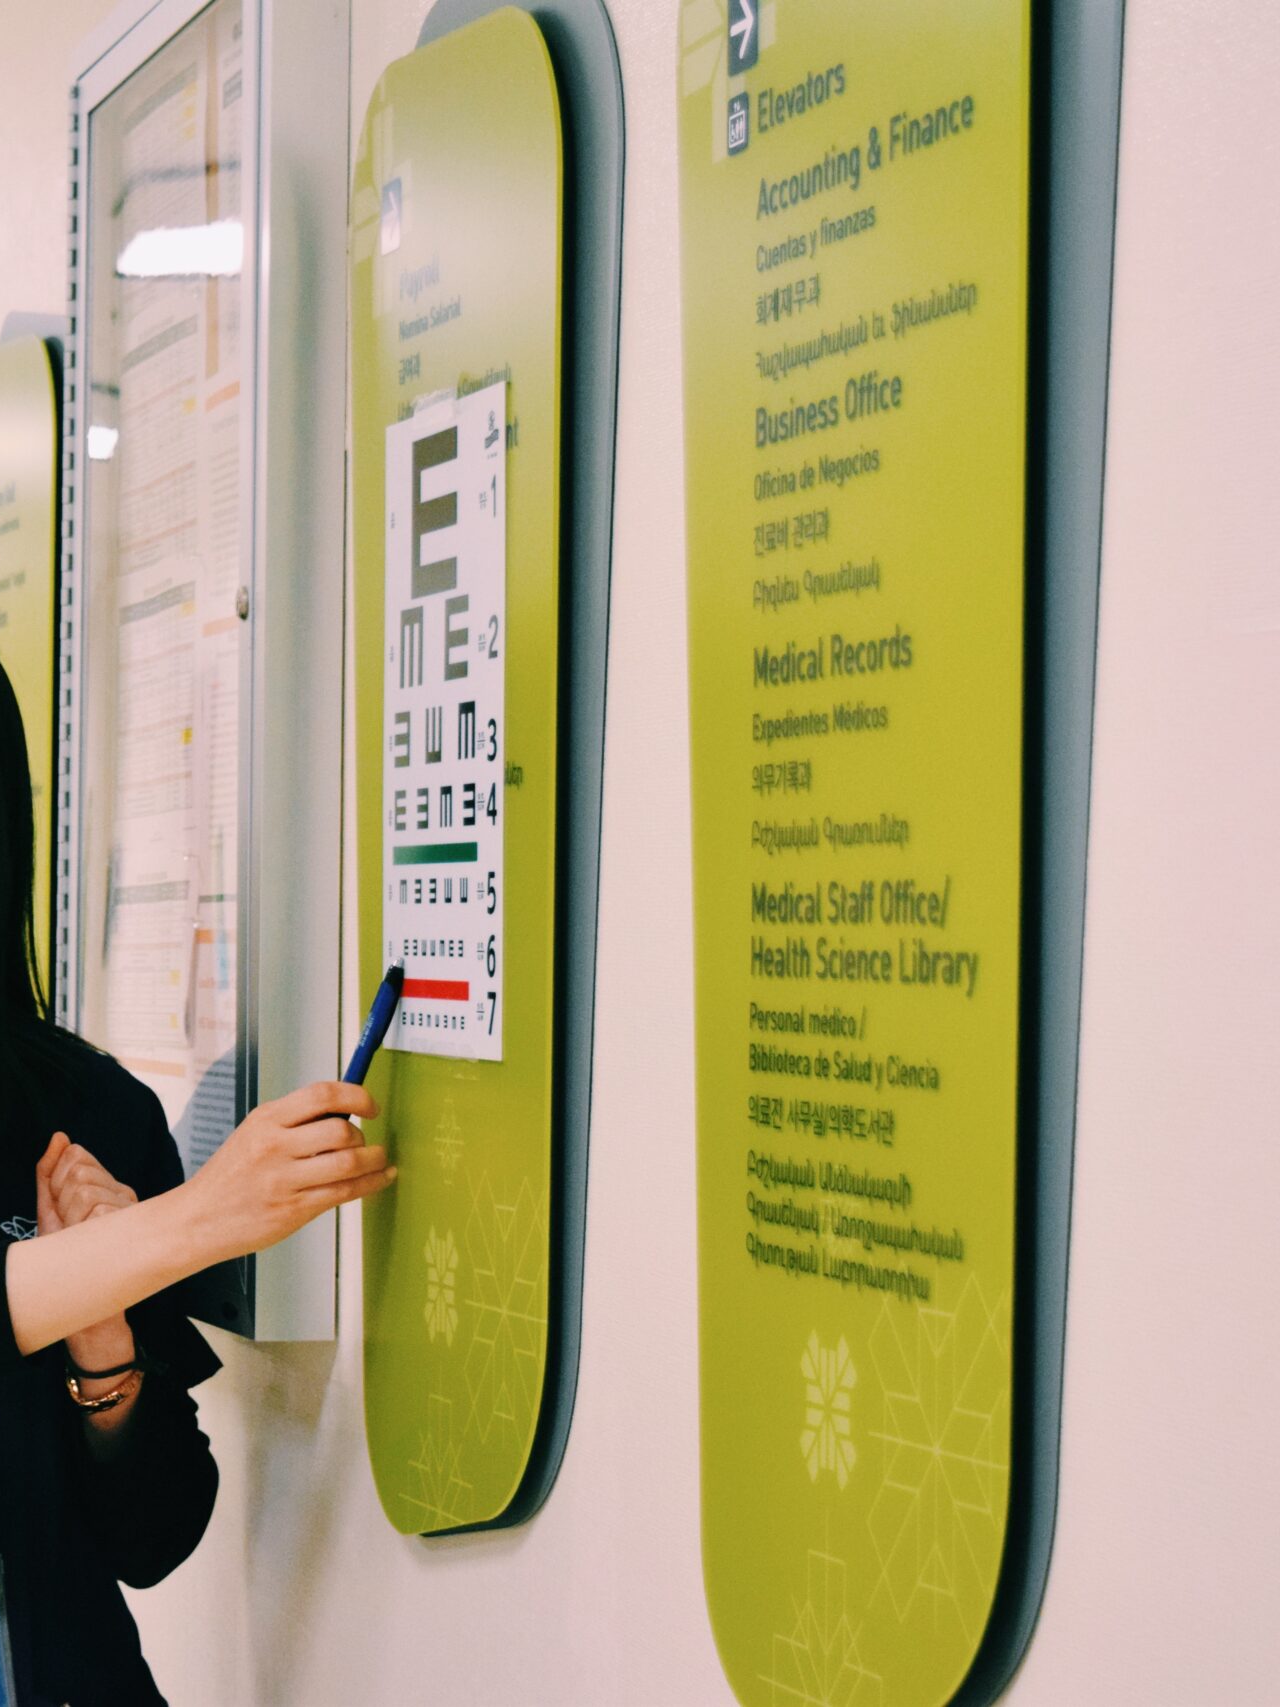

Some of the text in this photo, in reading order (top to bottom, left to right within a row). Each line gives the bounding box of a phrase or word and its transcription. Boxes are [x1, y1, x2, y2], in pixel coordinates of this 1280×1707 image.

[757, 63, 846, 134] Elevators
[756, 94, 975, 221] Accounting & Finance
[756, 205, 877, 272] Cuentas y finanzas
[755, 370, 904, 449] Business Office
[490, 474, 497, 519] 1
[754, 445, 881, 502] Oficina de Negocios
[411, 425, 458, 600] E
[488, 614, 499, 660] 2
[753, 623, 913, 688] Medical Records
[486, 718, 498, 762] 3
[752, 709, 829, 746] Expedientes
[486, 782, 498, 827] 4
[486, 871, 497, 916] 5
[751, 874, 952, 930] Medical Staff Office/
[486, 934, 497, 979] 6
[751, 935, 979, 1000] Health Science Library
[486, 991, 497, 1037] 7
[749, 1001, 806, 1035] Personal
[748, 1043, 941, 1092] Biblioteca de Salud y Ciencia
